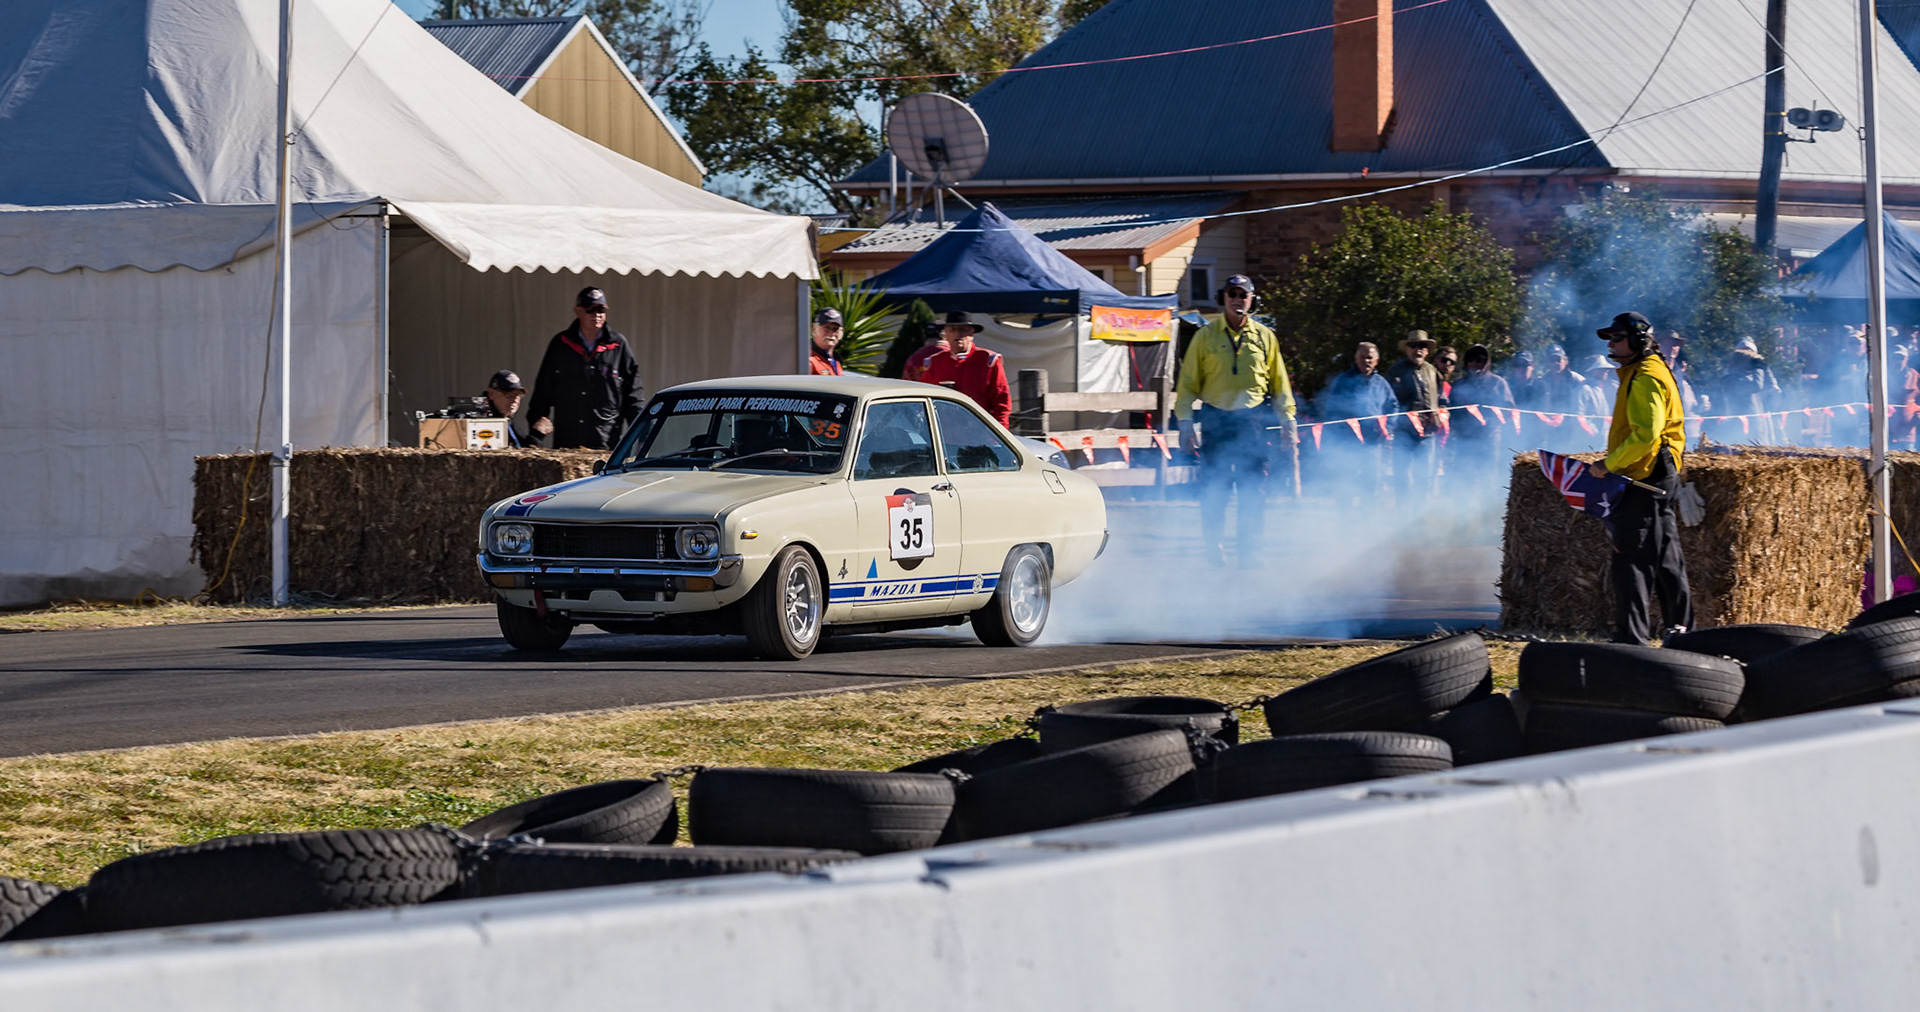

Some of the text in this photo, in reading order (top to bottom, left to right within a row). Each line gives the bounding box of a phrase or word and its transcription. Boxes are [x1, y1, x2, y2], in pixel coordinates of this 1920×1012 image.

[673, 397, 820, 415] MORGAN PARK PERFORMANCE
[808, 420, 841, 439] 35
[900, 517, 923, 550] 35
[869, 583, 917, 597] MAZDA
